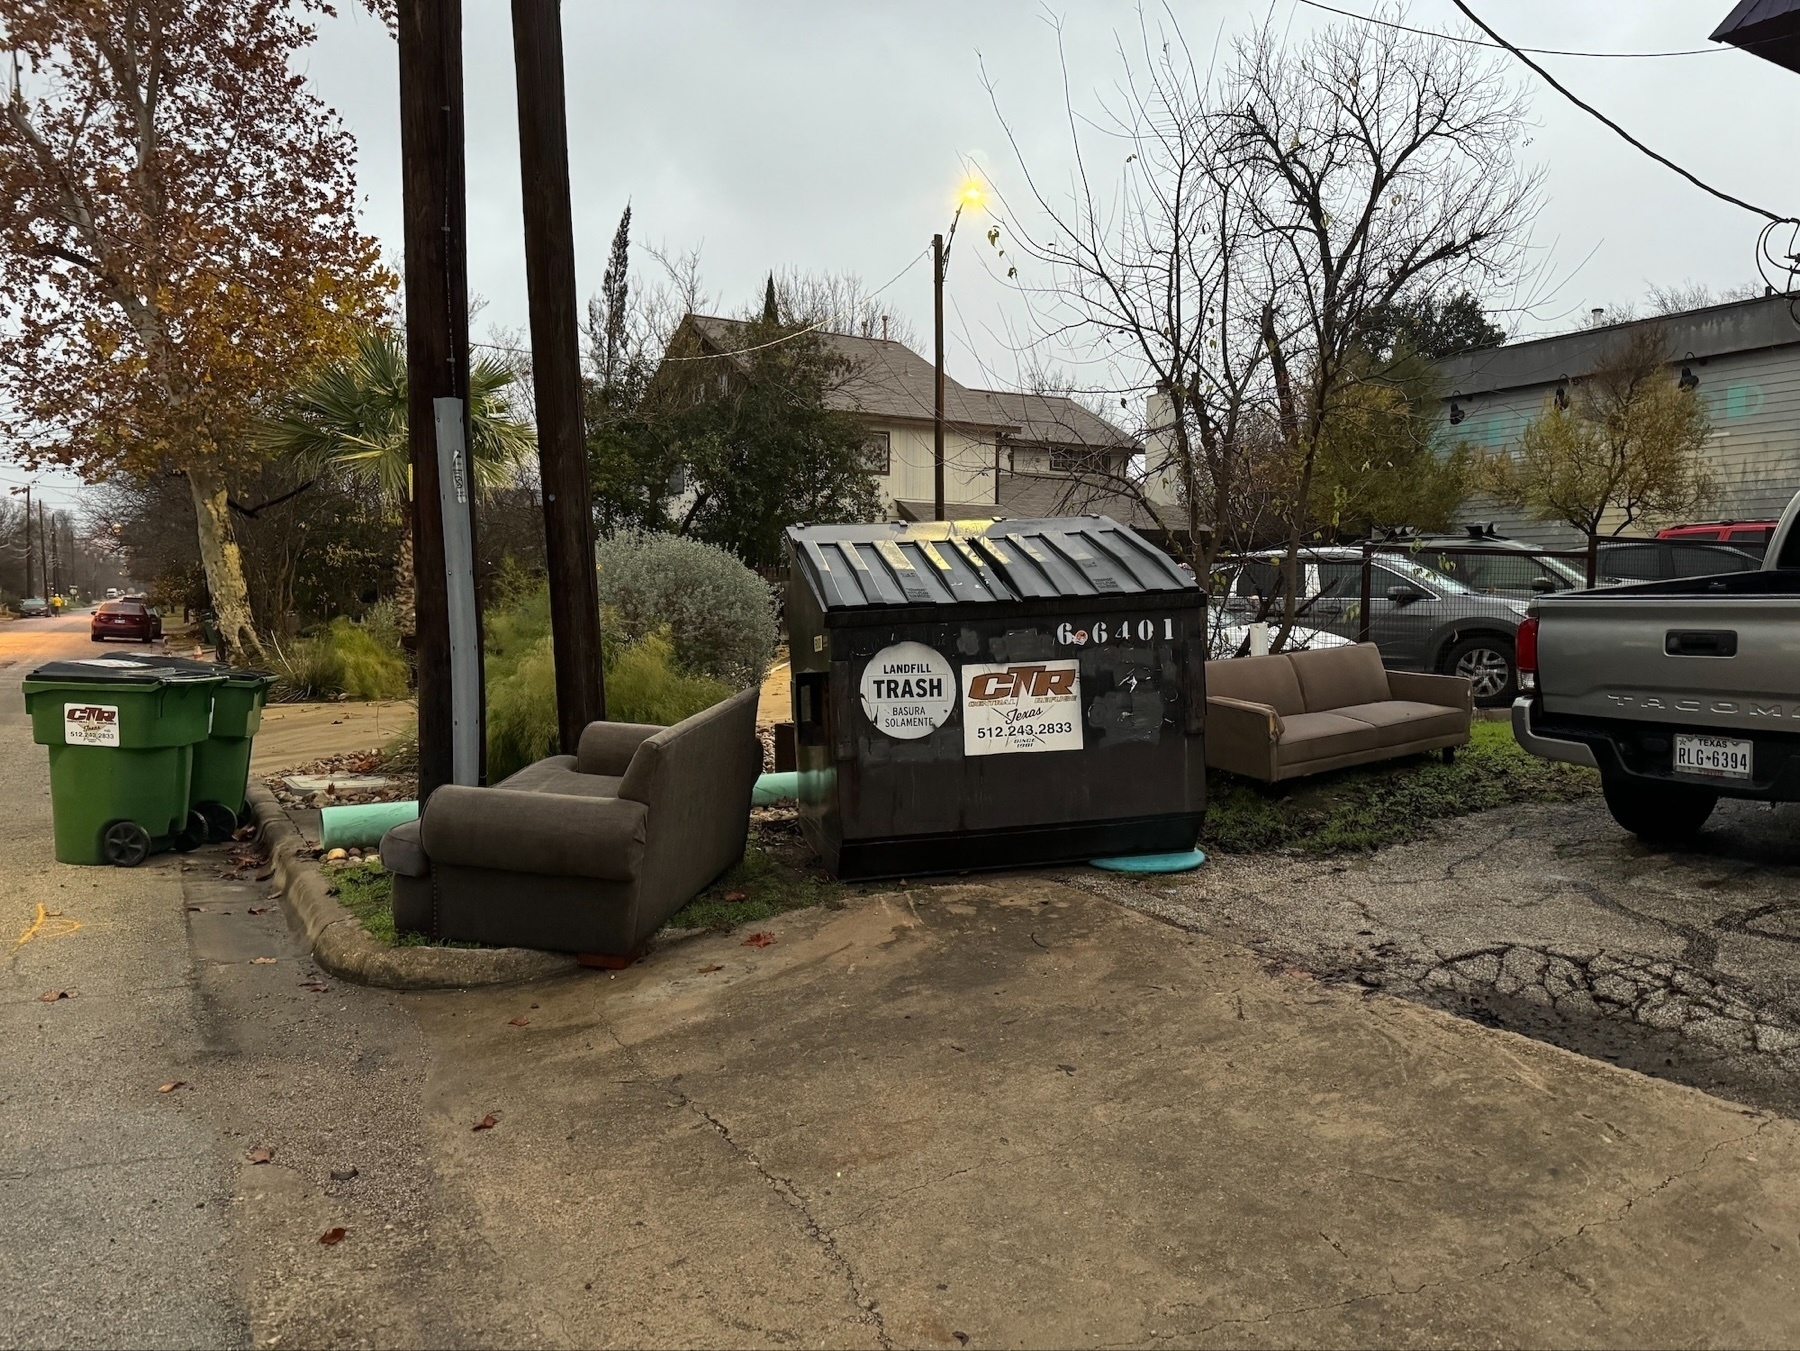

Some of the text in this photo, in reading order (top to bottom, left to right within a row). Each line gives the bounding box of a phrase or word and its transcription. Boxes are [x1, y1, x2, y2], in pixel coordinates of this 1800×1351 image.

[883, 664, 931, 674] LANDFILL
[873, 678, 942, 698] TRASH
[892, 706, 926, 716] BASURA
[1005, 707, 1043, 725] Texas
[885, 717, 934, 728] SOLAMENTE
[977, 722, 1073, 739] 512.243.2833
[1697, 738, 1728, 749] TEXAS
